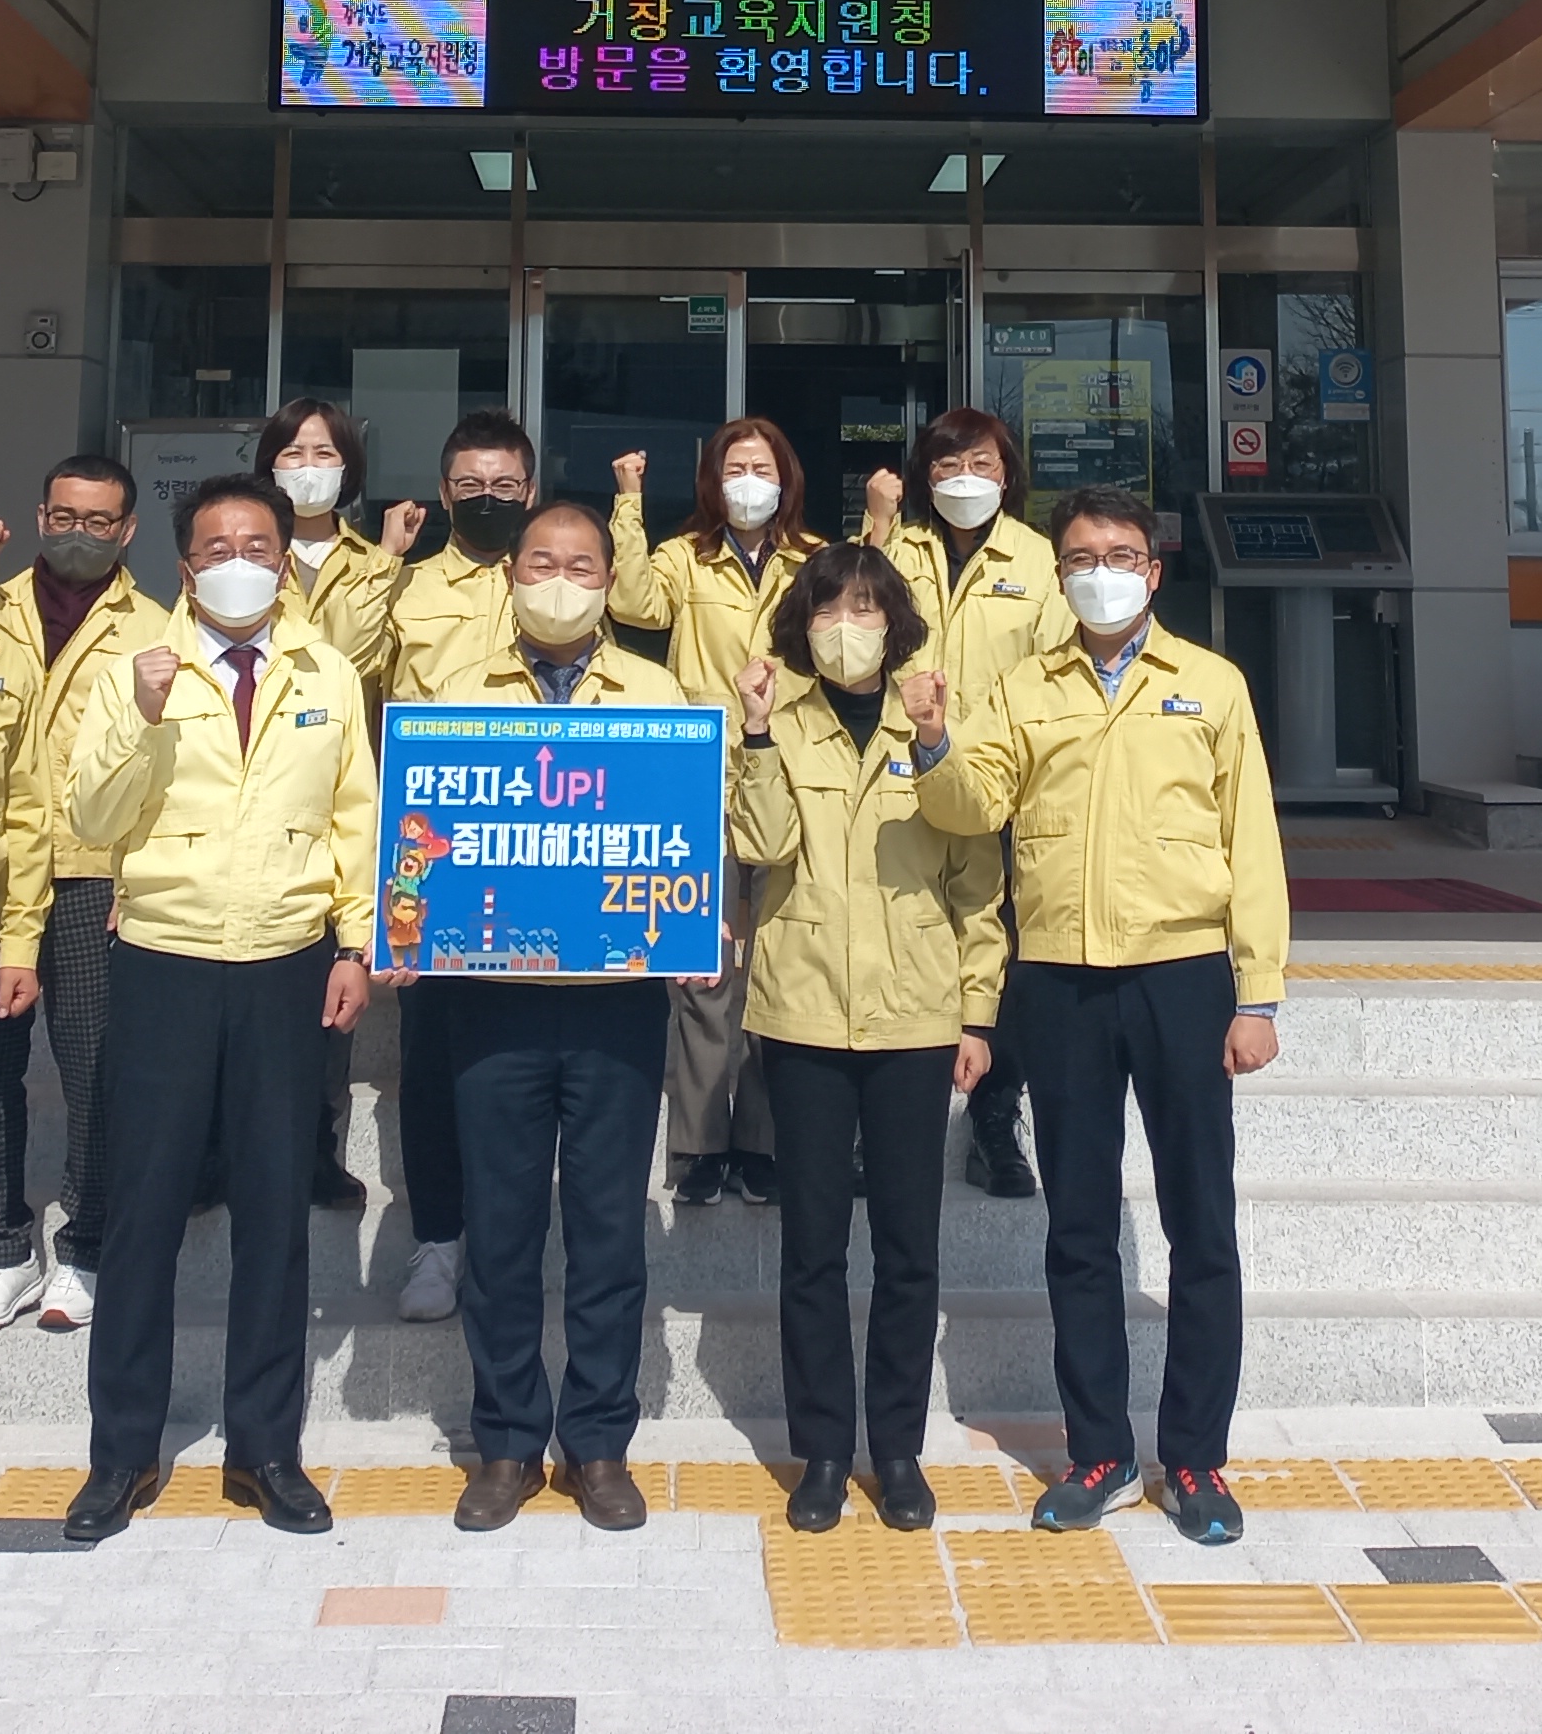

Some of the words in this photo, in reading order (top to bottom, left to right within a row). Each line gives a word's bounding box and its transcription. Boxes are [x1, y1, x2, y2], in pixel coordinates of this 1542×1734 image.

[341, 32, 478, 77] 거창교육지원청
[538, 45, 691, 92] 방문을
[715, 46, 988, 95] 환영합니다.
[399, 719, 486, 737] 중대재해처벌법
[489, 720, 538, 737] 인식제고
[541, 721, 566, 739] UP,
[568, 721, 605, 738] 군민의
[607, 722, 645, 739] 생명과
[646, 722, 672, 739] 재산
[674, 723, 711, 740] 지킴이
[405, 766, 533, 806] 안전지수
[539, 766, 606, 811] UP!
[451, 822, 691, 868] 중대재해처벌지수
[600, 872, 710, 916] ZERO!
